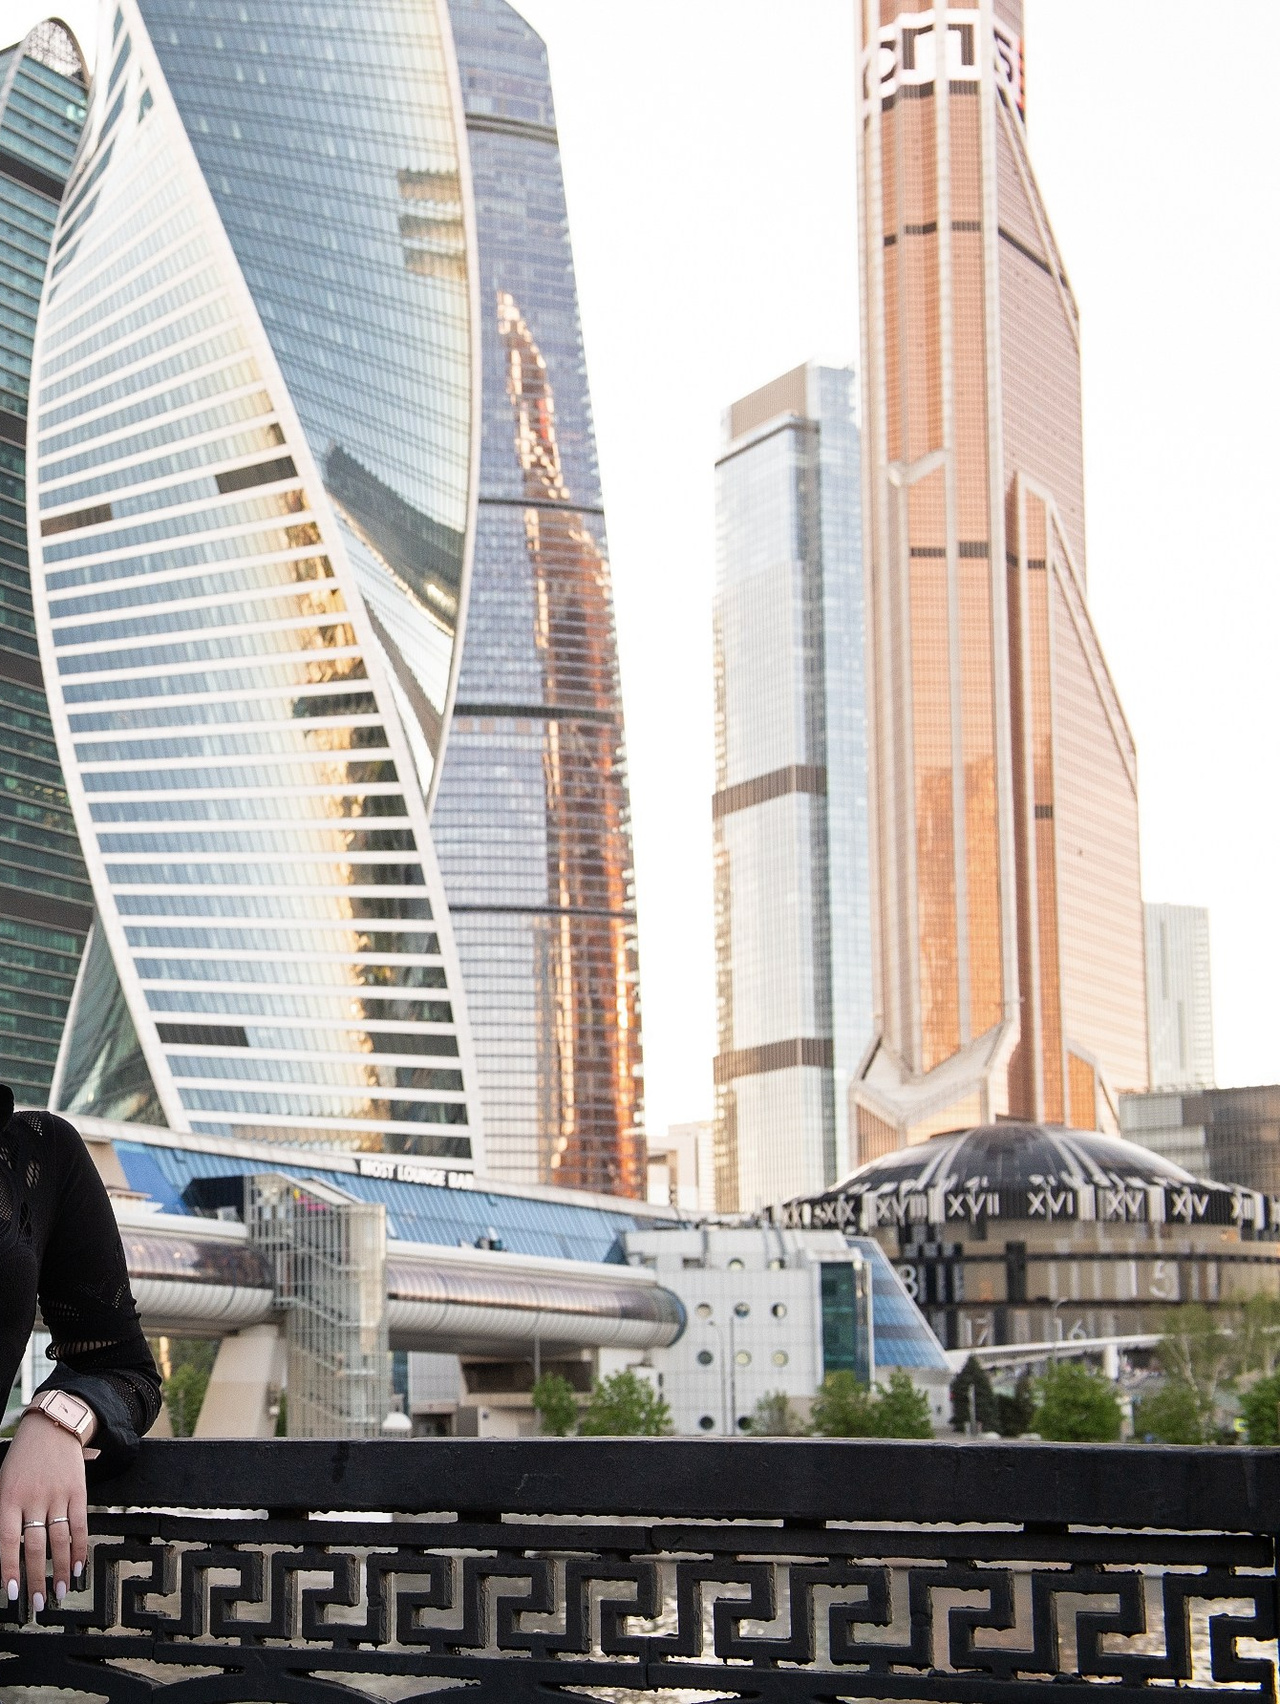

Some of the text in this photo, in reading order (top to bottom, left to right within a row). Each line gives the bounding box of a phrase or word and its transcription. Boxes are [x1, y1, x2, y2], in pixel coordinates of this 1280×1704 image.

[360, 1159, 396, 1179] MOST
[398, 1164, 446, 1187] LOUNGE
[947, 1193, 1000, 1217] XVII
[1027, 1191, 1073, 1216] XVI
